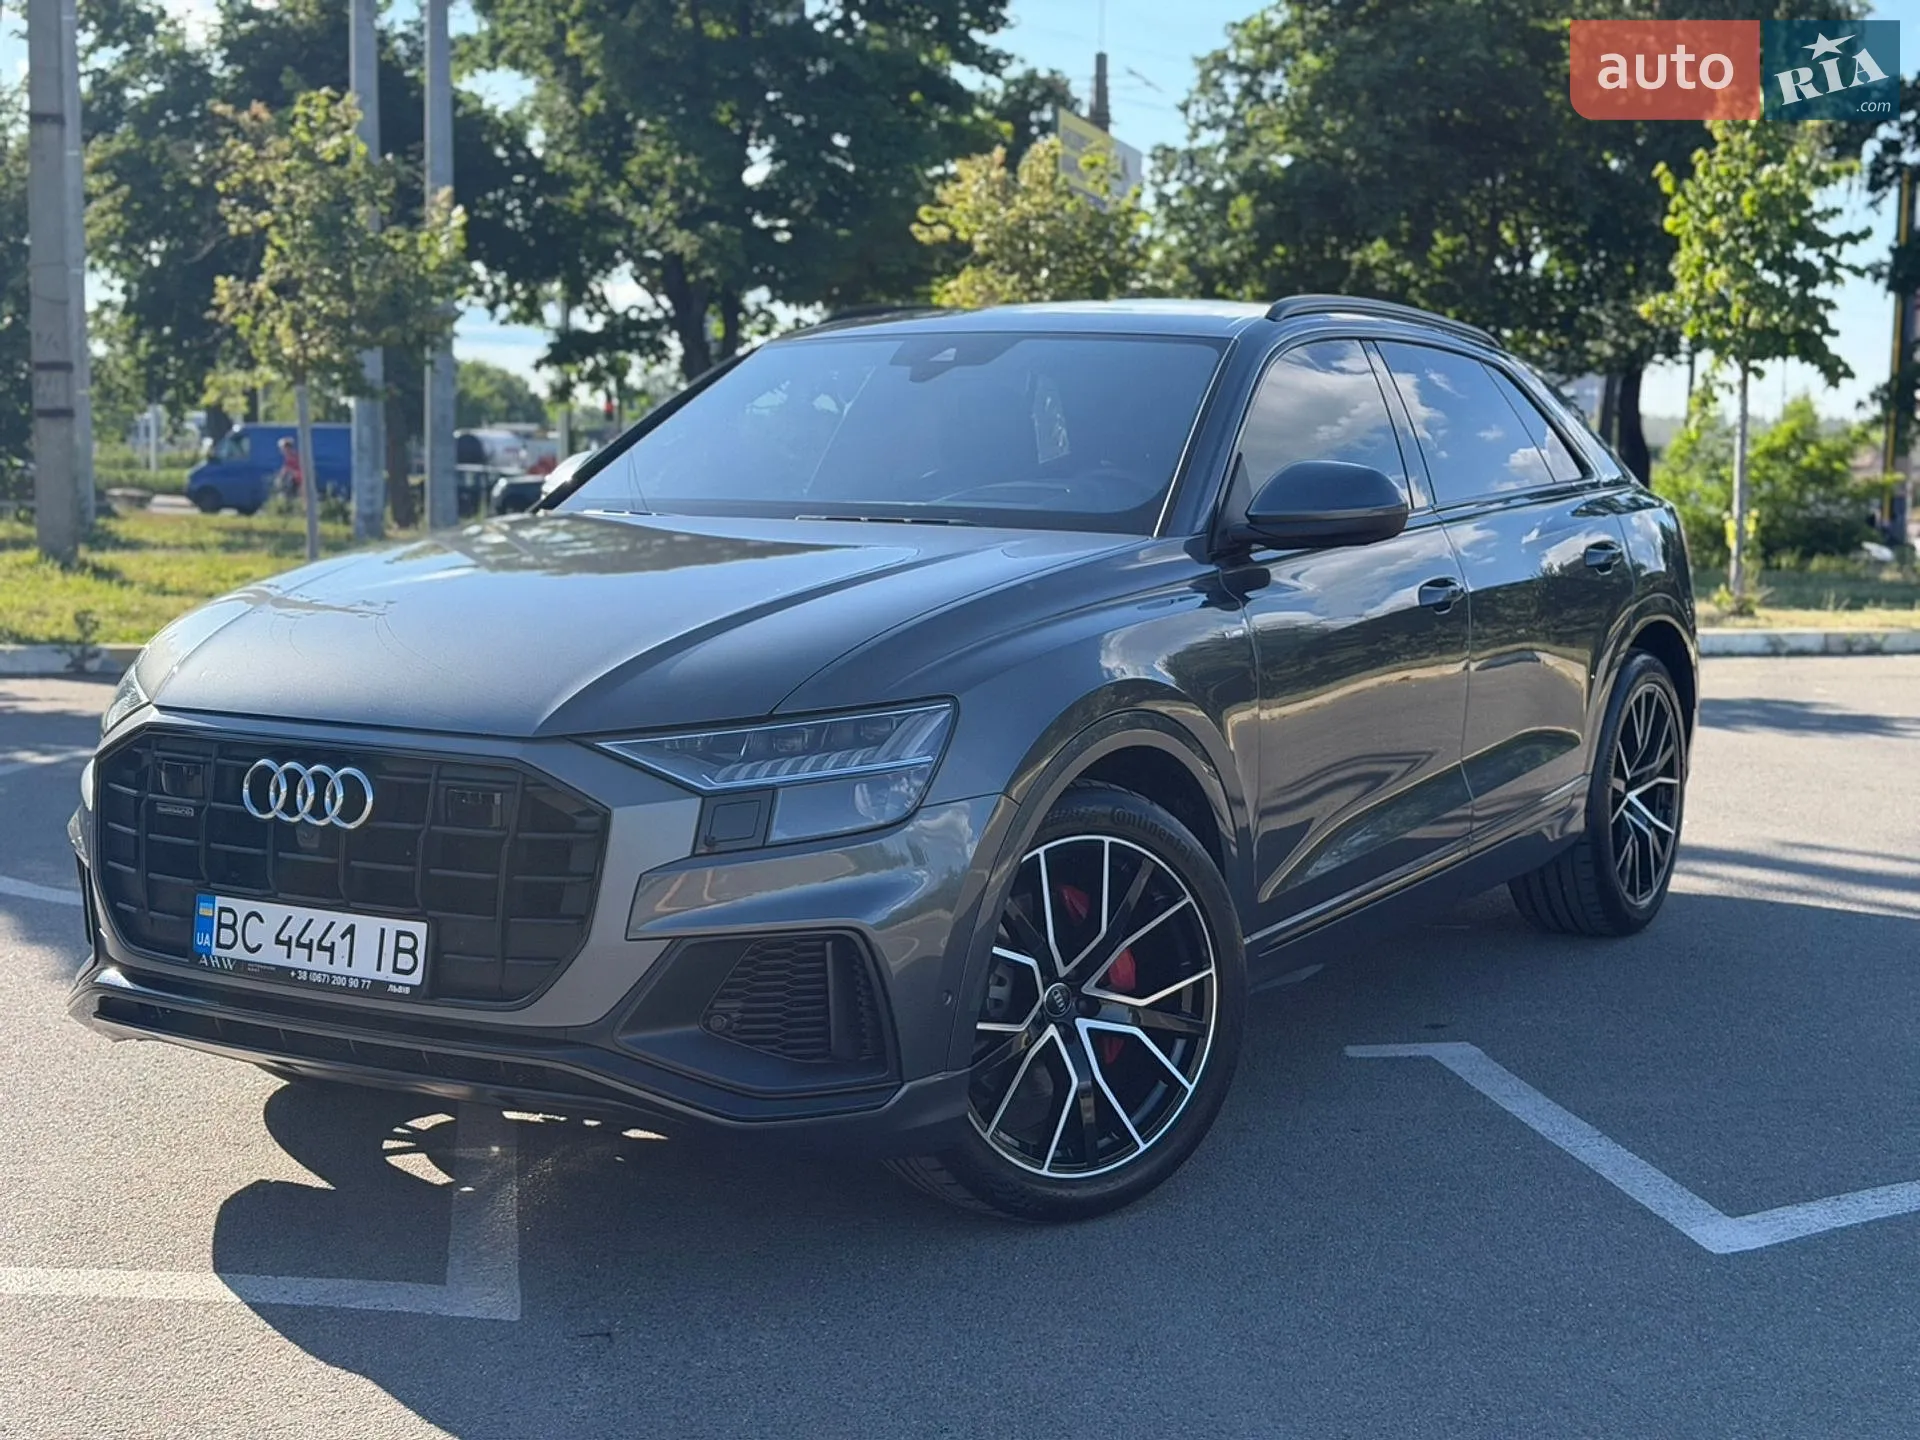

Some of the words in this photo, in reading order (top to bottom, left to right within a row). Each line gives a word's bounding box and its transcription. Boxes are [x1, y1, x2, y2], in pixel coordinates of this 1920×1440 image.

[1111, 805, 1194, 862] Continental
[196, 932, 211, 947] UA
[215, 906, 265, 954] BC
[274, 915, 356, 968] 4441
[376, 927, 419, 976] IB
[331, 975, 347, 987] 200
[348, 977, 359, 989] 90
[361, 979, 372, 990] 77
